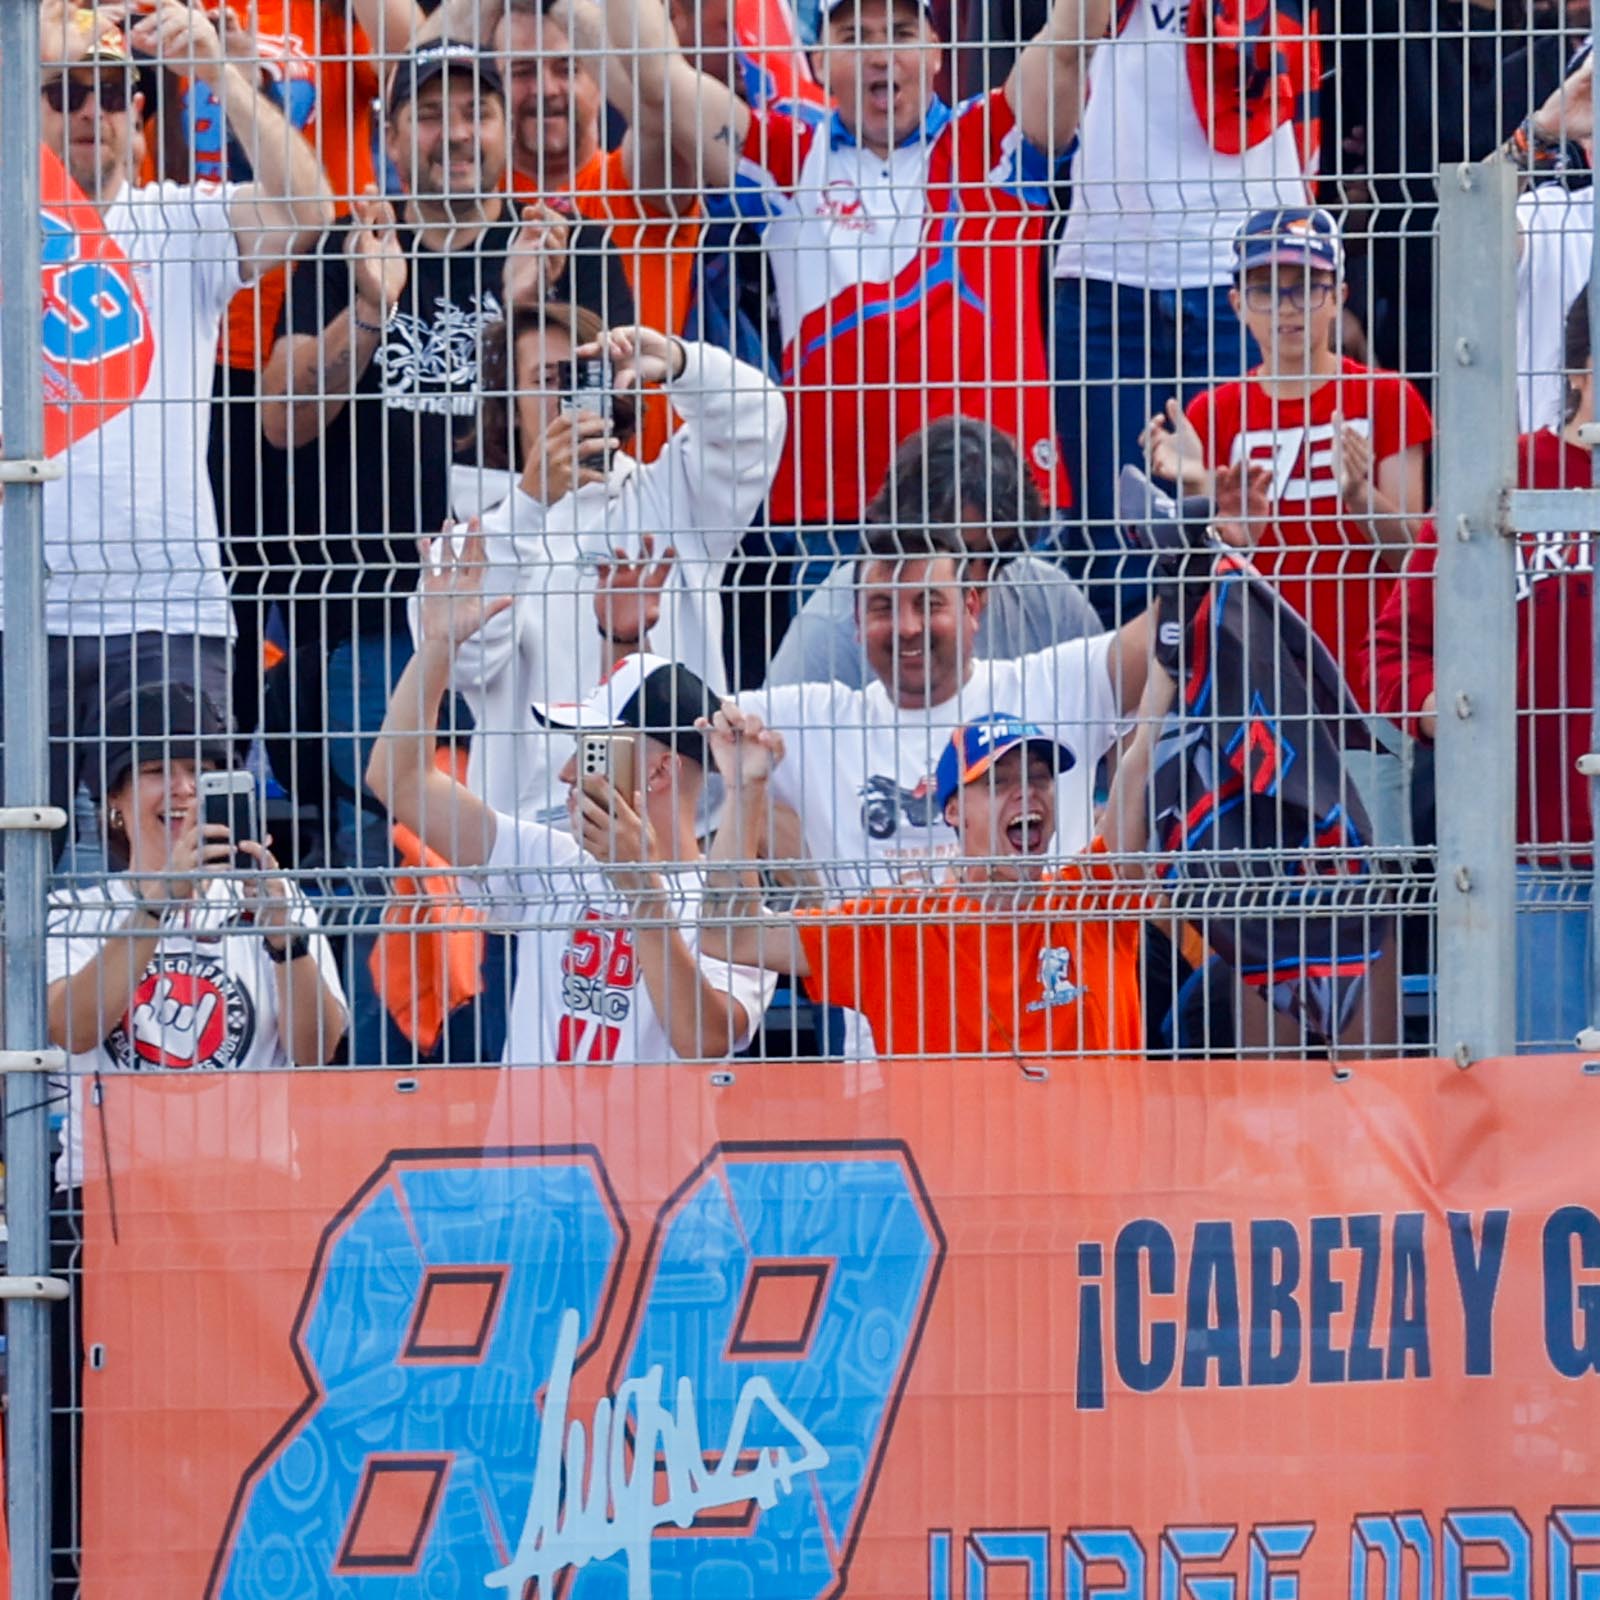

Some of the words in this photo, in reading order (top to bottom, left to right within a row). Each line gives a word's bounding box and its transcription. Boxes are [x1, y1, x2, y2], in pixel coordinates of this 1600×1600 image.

[562, 905, 640, 990] 58
[1076, 1213, 1431, 1411] ¡CABEZA
[1447, 1208, 1510, 1376] Y
